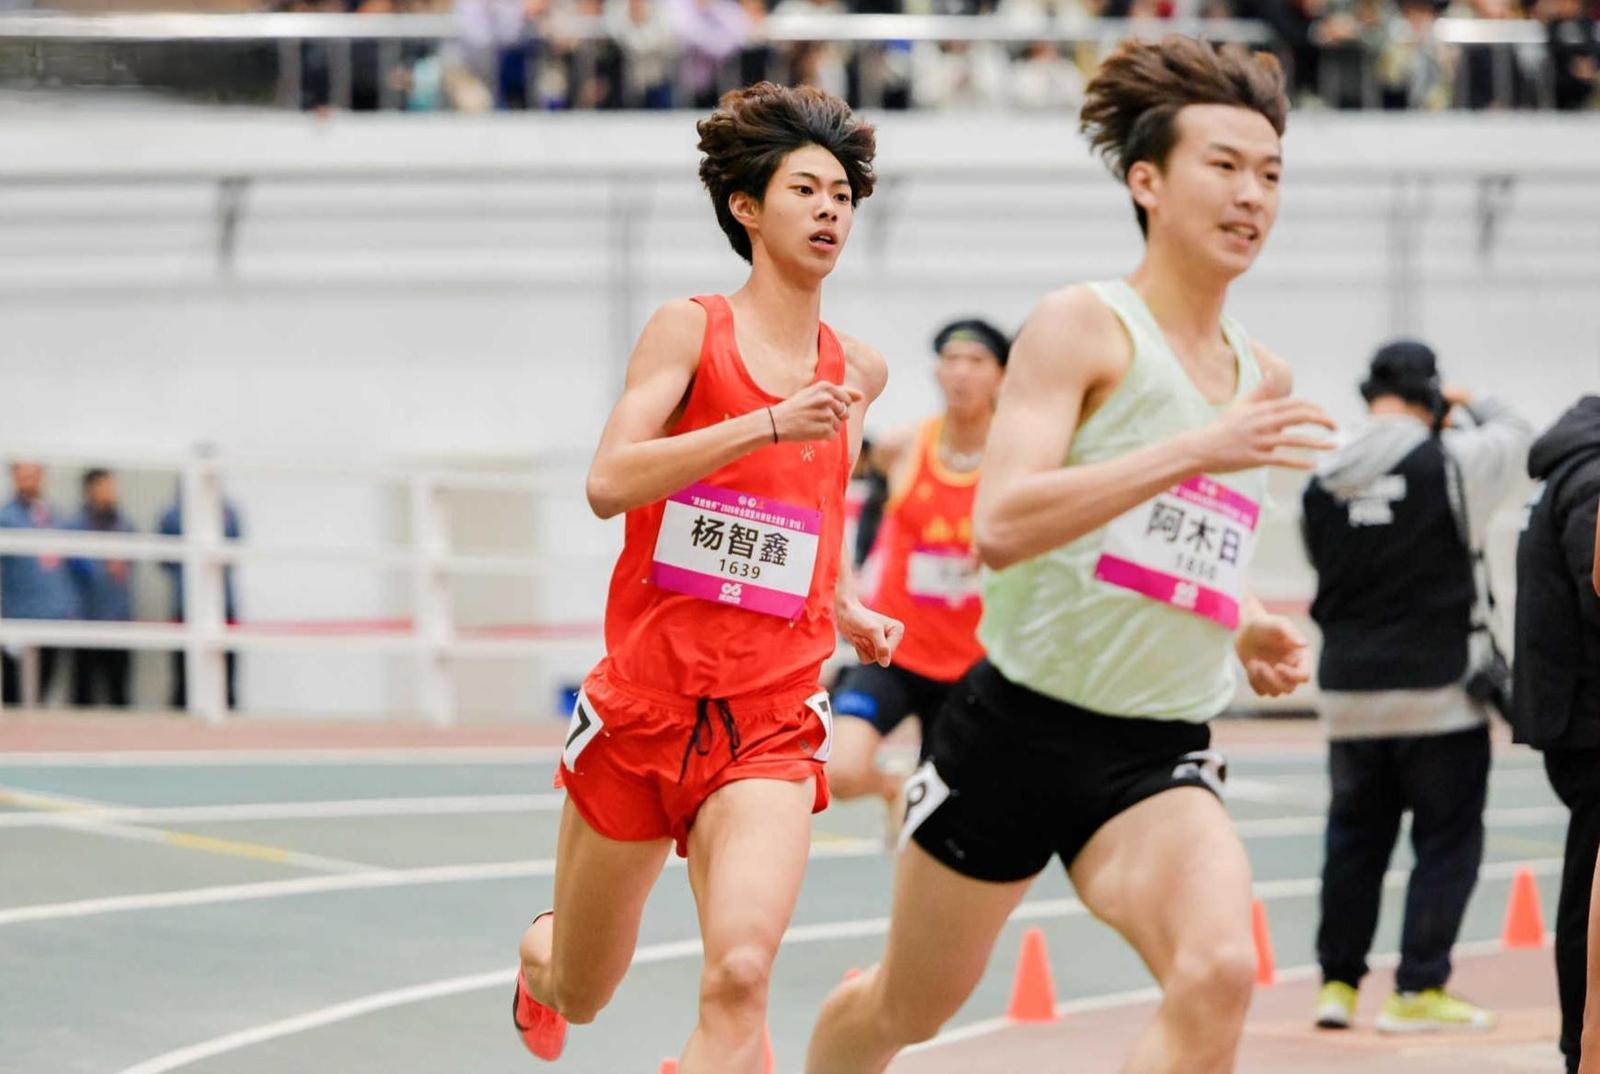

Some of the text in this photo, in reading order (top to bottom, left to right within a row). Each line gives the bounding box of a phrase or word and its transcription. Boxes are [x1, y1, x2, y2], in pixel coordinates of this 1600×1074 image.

[691, 514, 789, 566] 杨智鑫
[1146, 501, 1240, 566] 阿木日
[719, 559, 761, 579] 1639
[565, 701, 591, 750] 7
